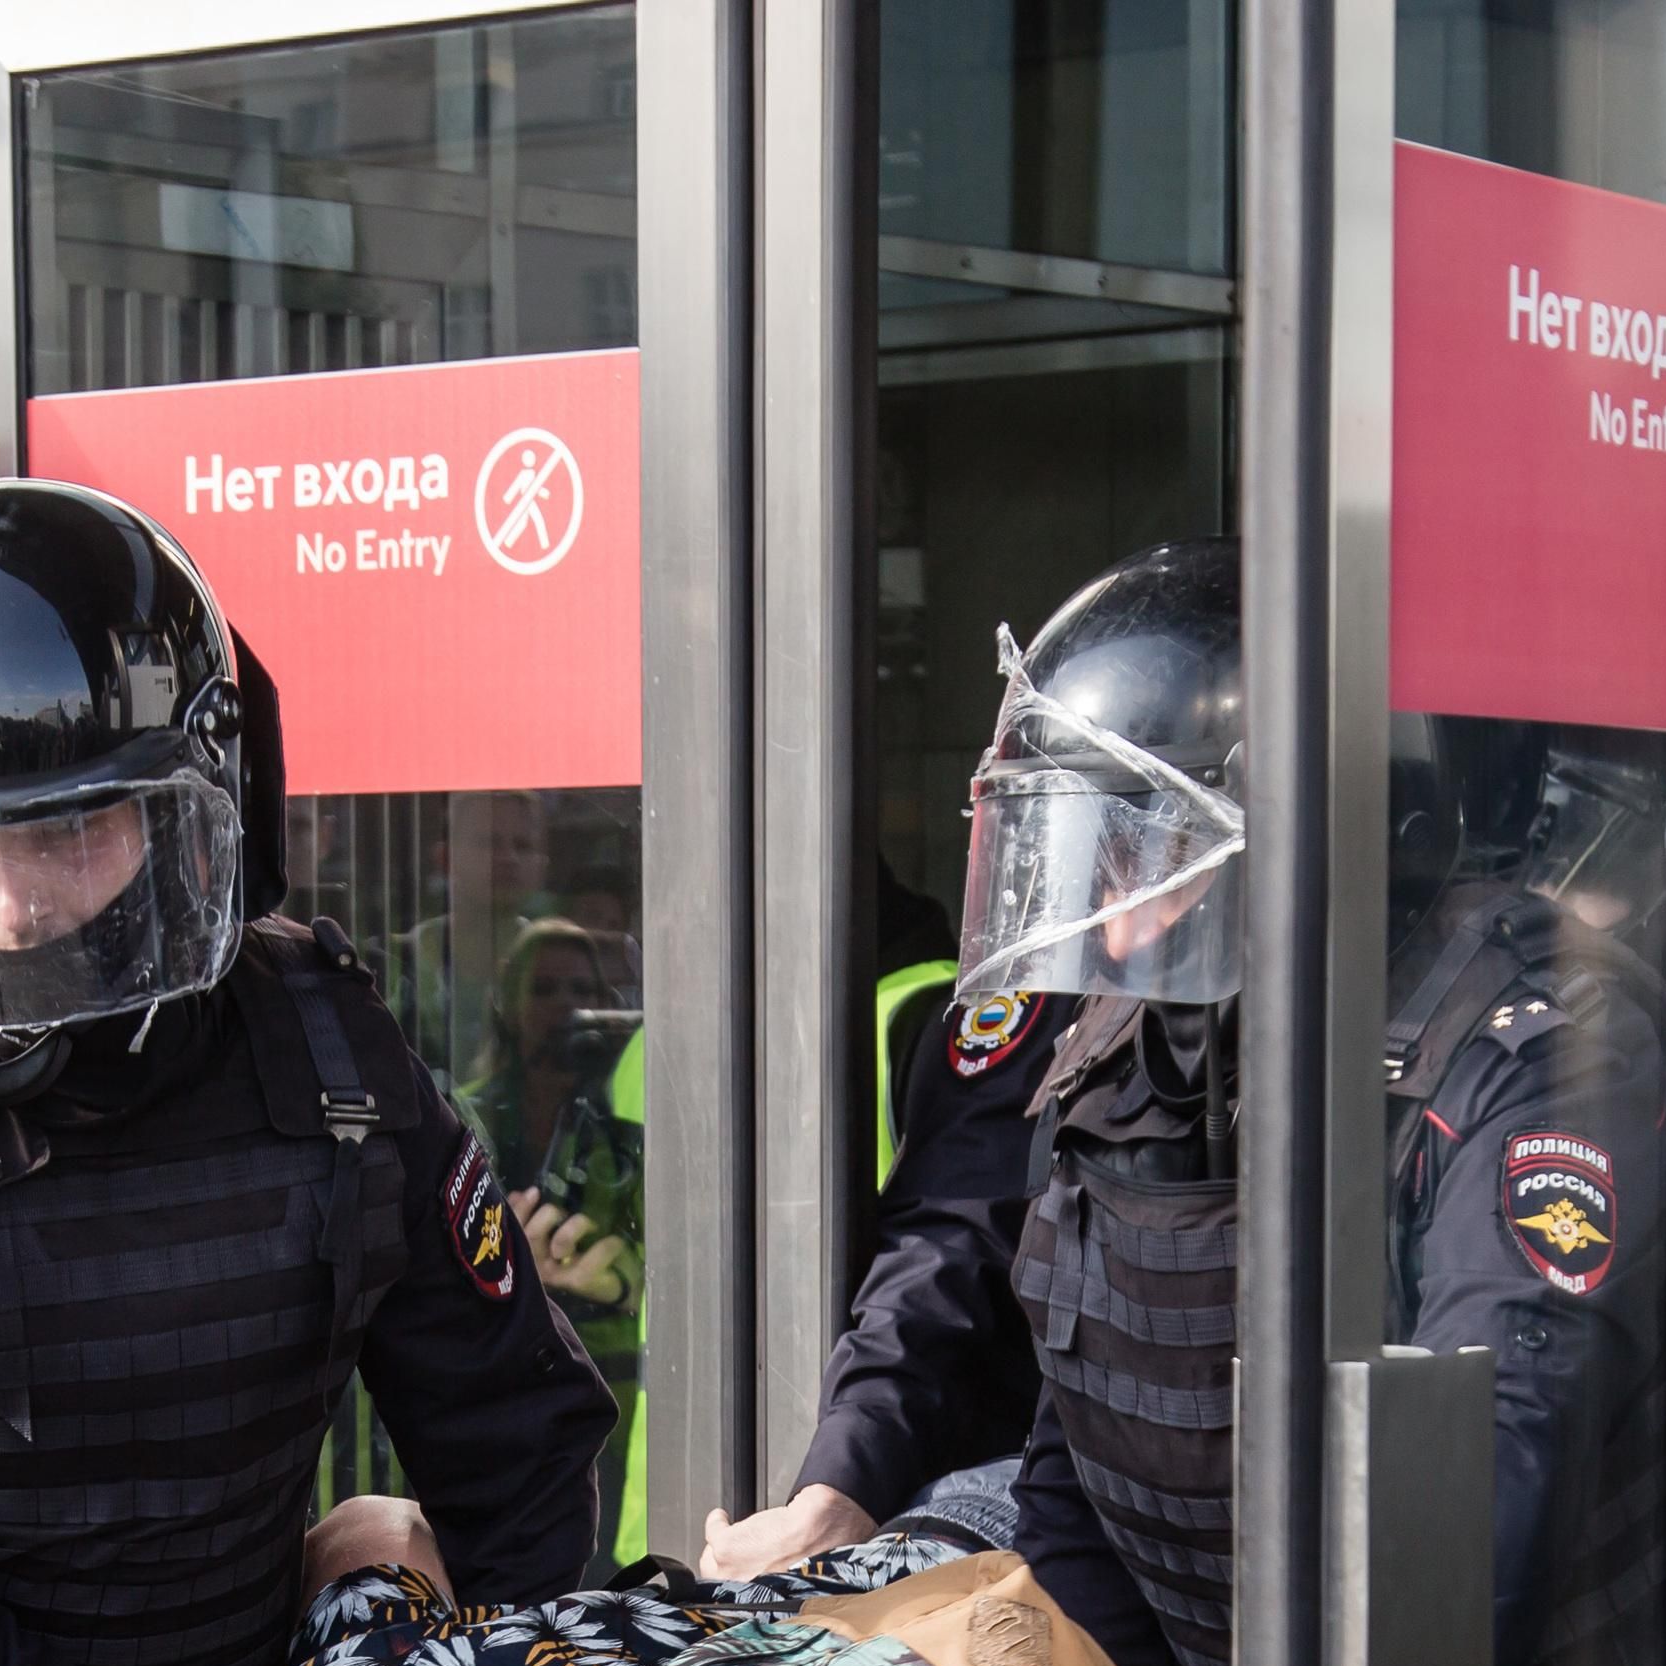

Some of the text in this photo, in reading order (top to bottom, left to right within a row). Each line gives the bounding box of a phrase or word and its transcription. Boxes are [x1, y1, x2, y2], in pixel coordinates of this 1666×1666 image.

[1508, 263, 1583, 351] Нет
[1589, 389, 1628, 446] No
[185, 453, 449, 515] Нет входа
[295, 527, 452, 577] No Entry
[1514, 1137, 1609, 1174] ПОЛИЦИЯ
[1516, 1171, 1607, 1212] РОССИЯ
